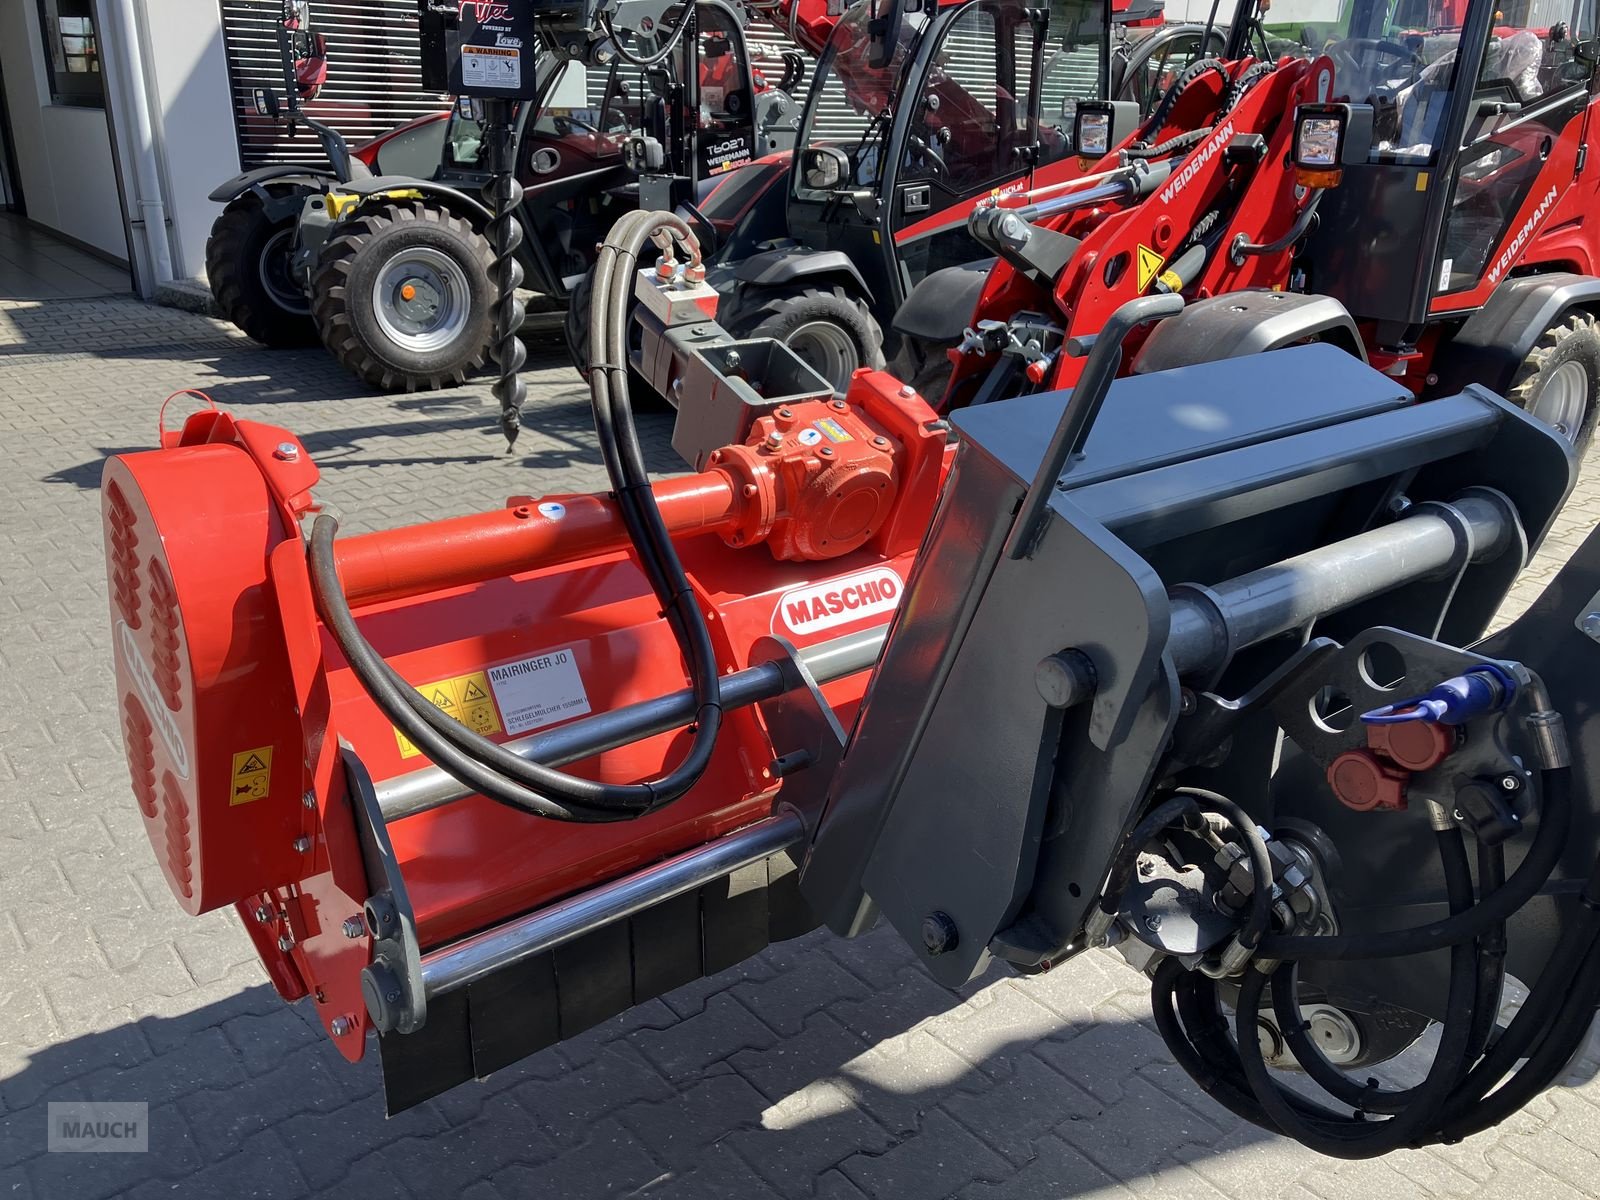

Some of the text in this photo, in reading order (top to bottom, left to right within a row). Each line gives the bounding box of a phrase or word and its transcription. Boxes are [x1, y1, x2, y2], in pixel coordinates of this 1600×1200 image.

[476, 48, 512, 56] WARNING
[706, 137, 744, 155] T6027
[707, 148, 750, 166] WEIDEMANN
[1160, 121, 1234, 204] WEIDEMANN
[1488, 185, 1557, 283] WEIDEMANN
[786, 578, 897, 625] MASCHIO
[490, 653, 567, 681] MAIRINGER JO
[476, 725, 493, 733] STOP
